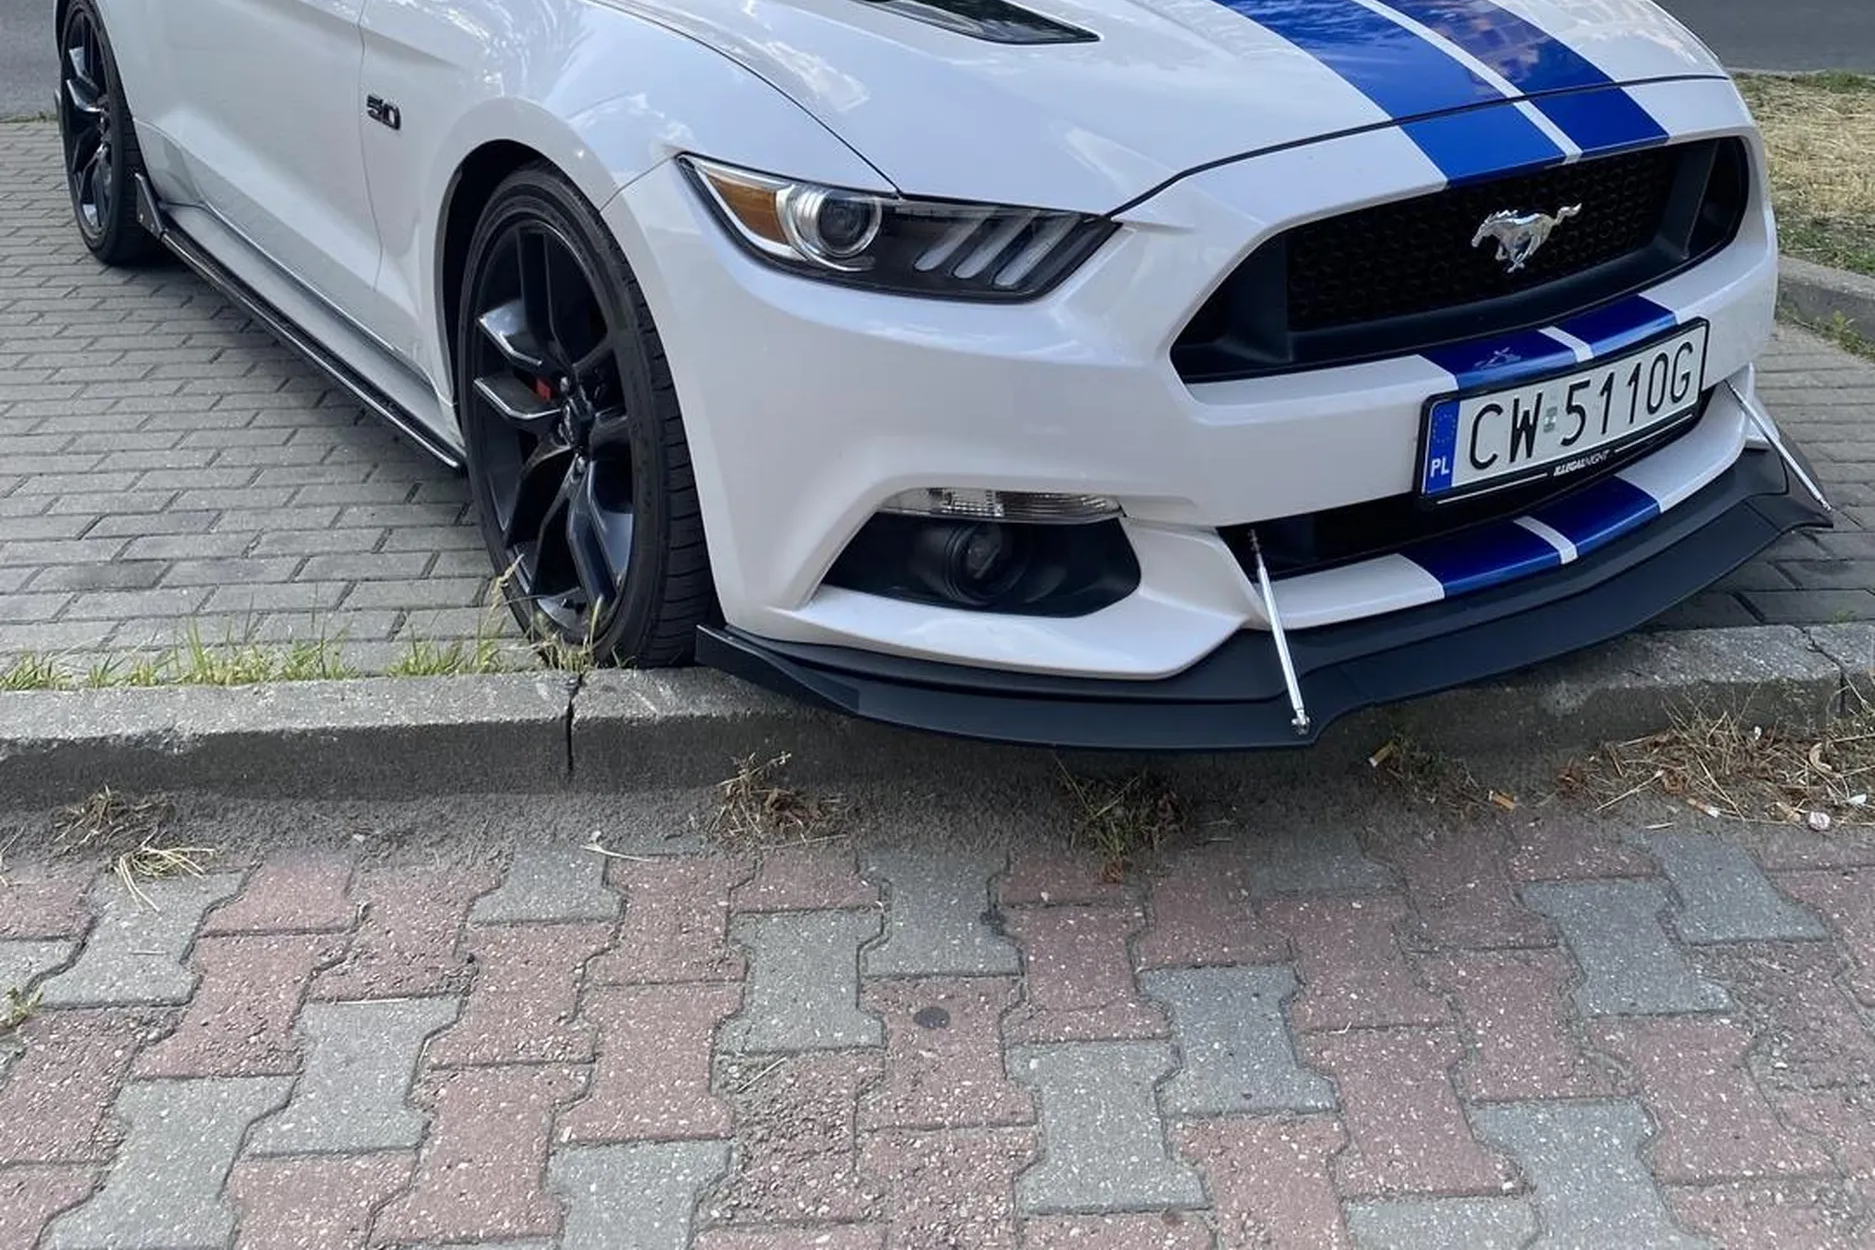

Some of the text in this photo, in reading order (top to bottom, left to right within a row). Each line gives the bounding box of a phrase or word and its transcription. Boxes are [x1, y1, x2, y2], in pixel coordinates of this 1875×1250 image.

[1469, 341, 1694, 470] CW 5110G
[1429, 456, 1451, 479] PL
